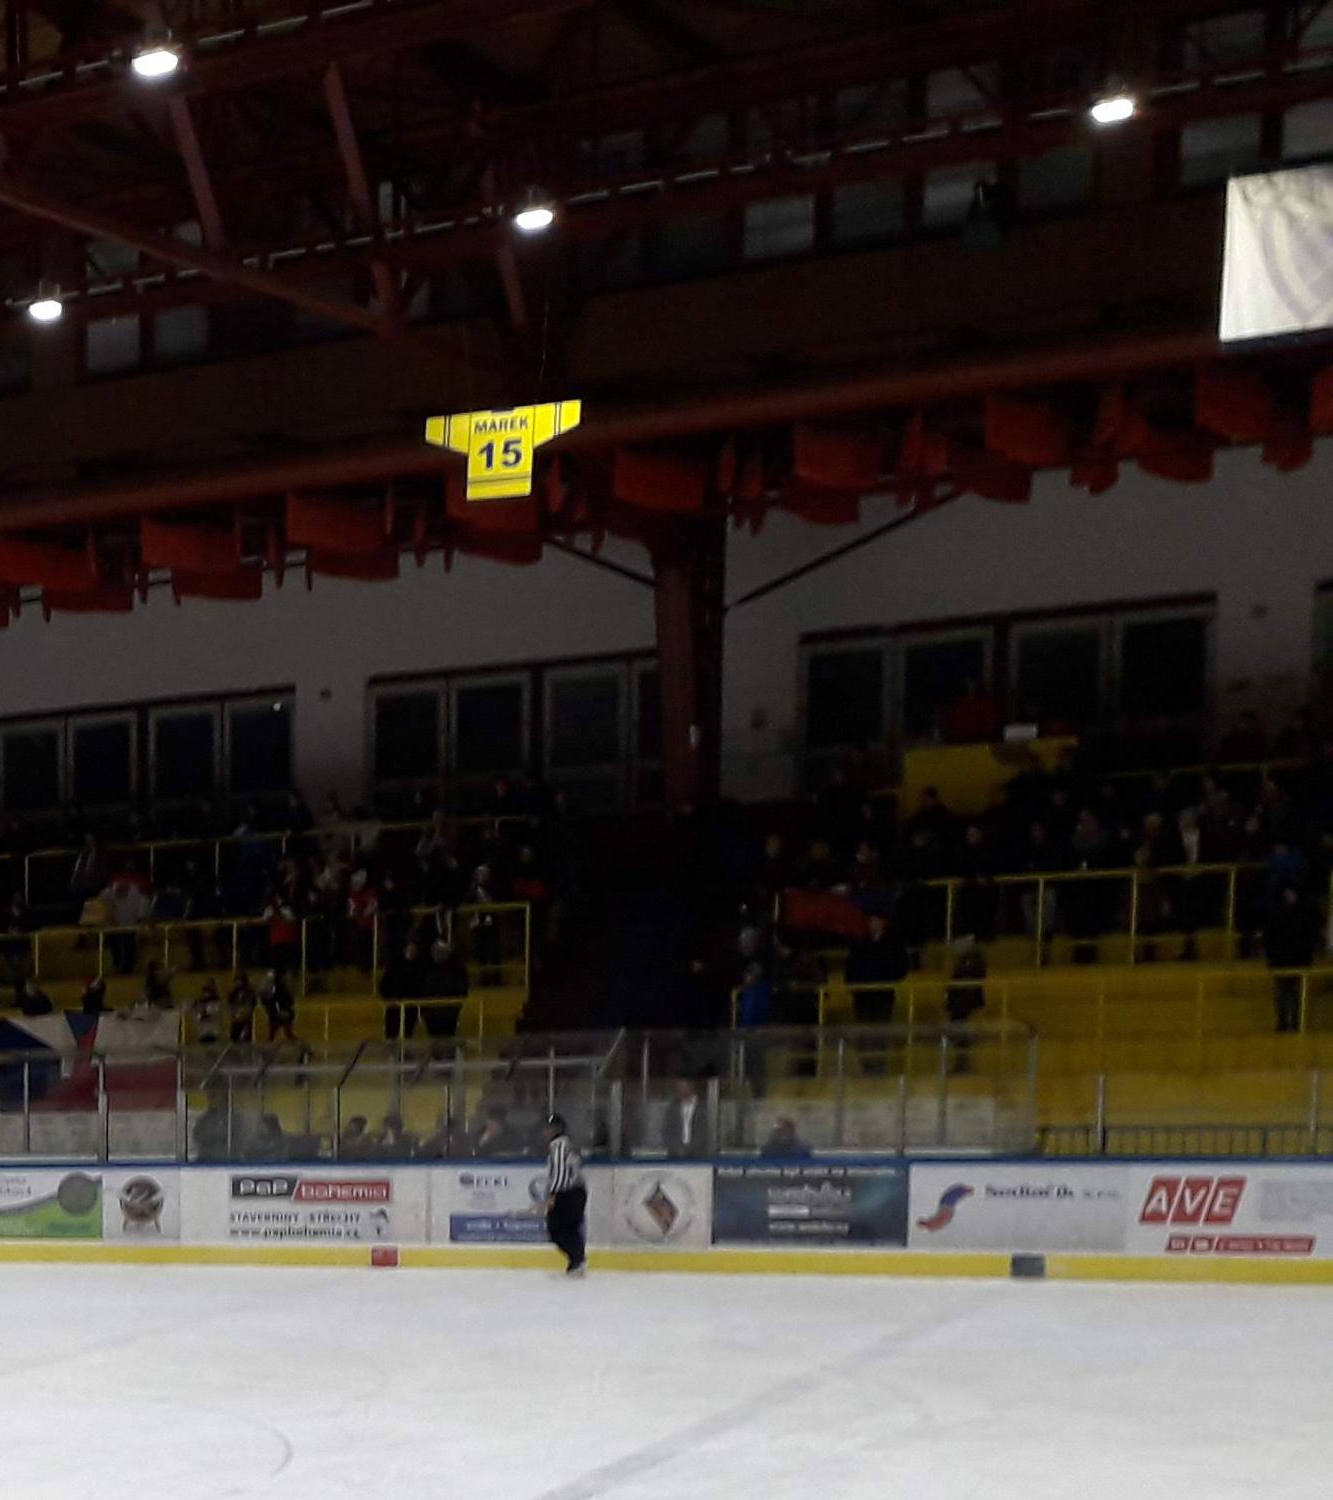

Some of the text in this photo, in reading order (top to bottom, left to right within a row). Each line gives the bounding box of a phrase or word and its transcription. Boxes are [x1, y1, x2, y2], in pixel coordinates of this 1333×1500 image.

[474, 416, 529, 434] MAREK
[478, 438, 523, 469] 15
[1144, 1184, 1239, 1216] AVE
